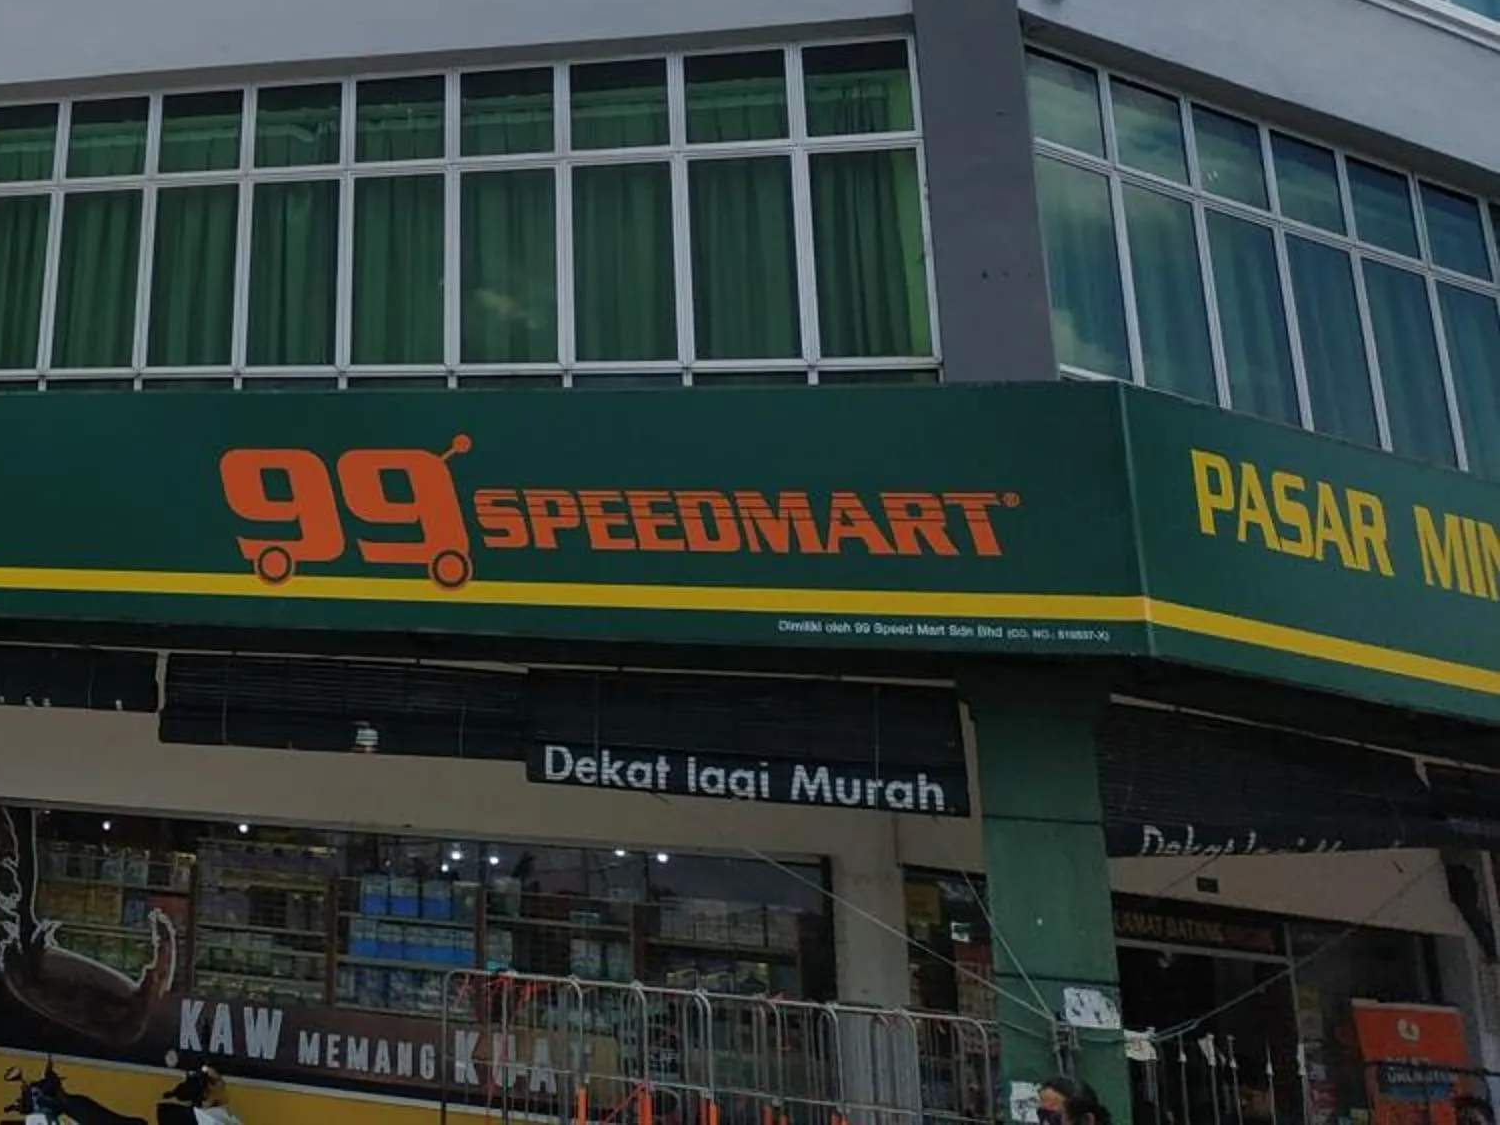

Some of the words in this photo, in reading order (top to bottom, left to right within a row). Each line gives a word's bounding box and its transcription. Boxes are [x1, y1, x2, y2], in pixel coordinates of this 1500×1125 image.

[219, 443, 474, 589] 99
[473, 487, 1007, 557] SPEEDMART
[1190, 448, 1395, 577] PASAR
[874, 621, 914, 636] Speed
[916, 623, 945, 636] Mart
[977, 625, 1003, 638] Bhd
[544, 744, 671, 790] Dekat
[790, 764, 946, 812] Murah
[178, 998, 284, 1061] KAW
[298, 1030, 436, 1081] MEMANG
